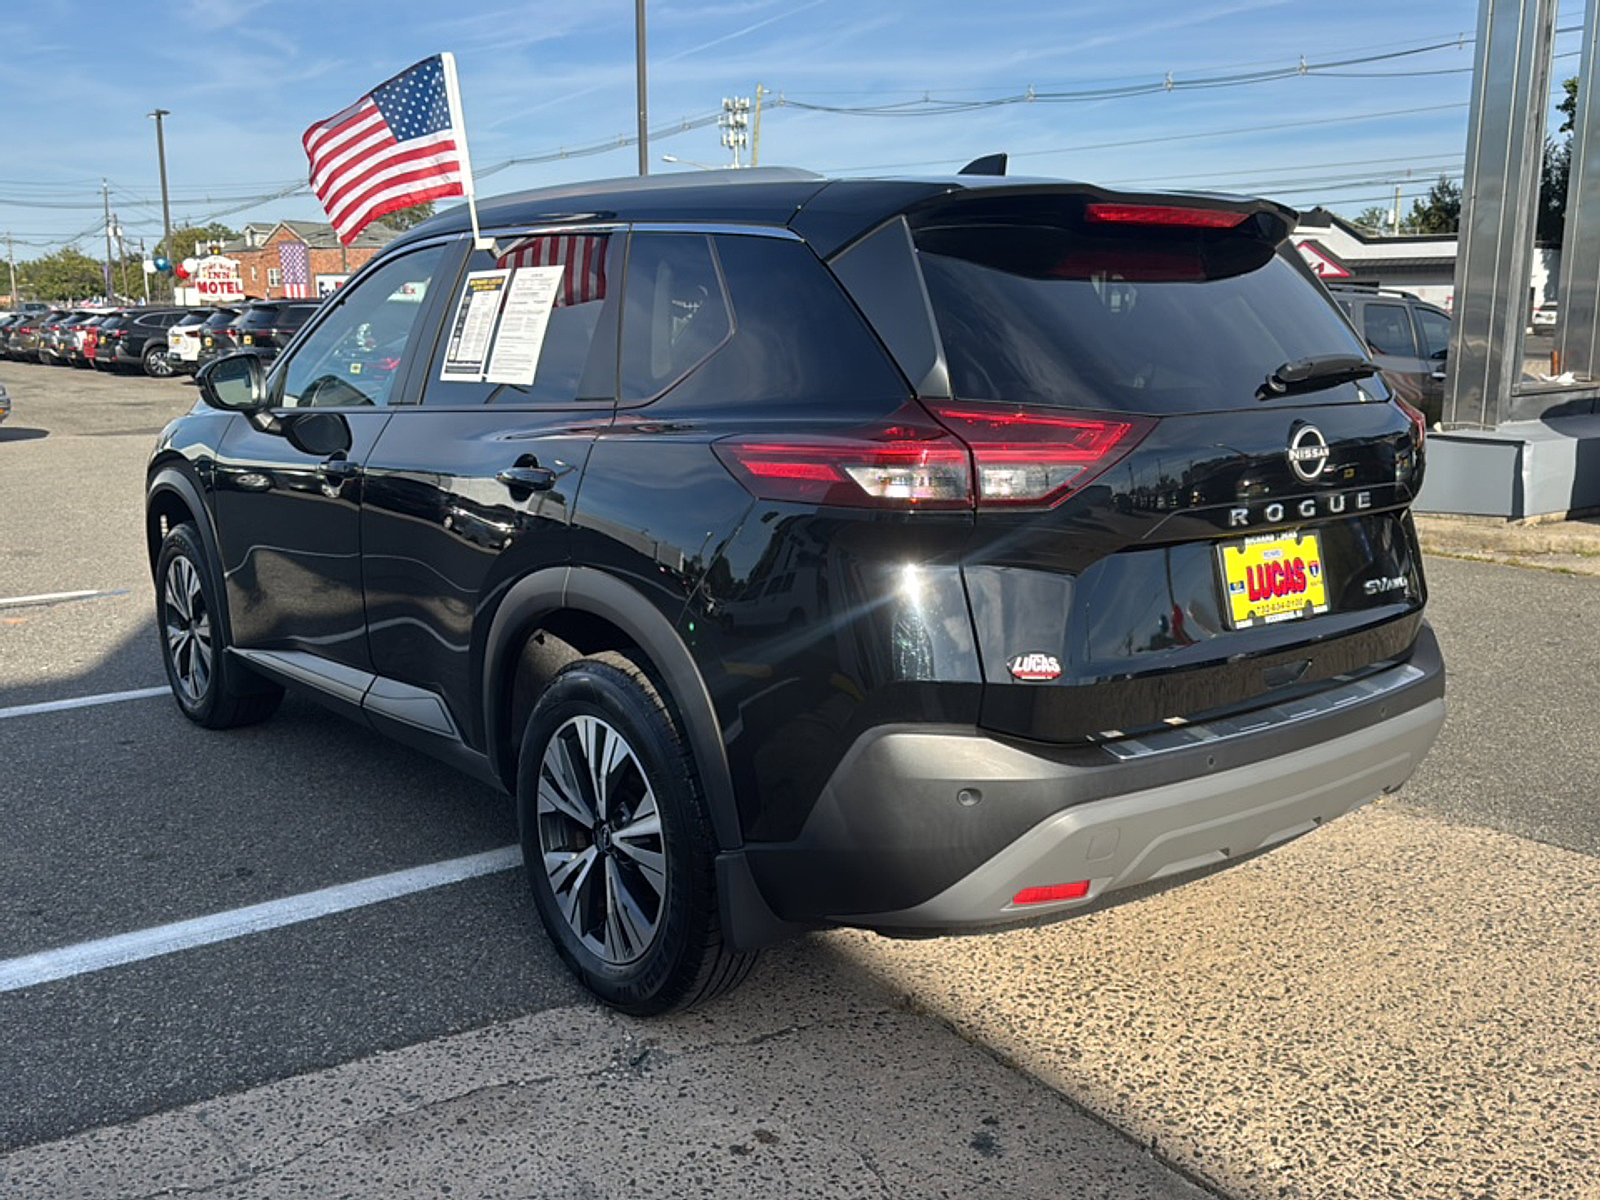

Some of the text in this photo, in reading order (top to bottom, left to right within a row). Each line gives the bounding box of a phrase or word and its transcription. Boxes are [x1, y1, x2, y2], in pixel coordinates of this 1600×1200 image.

[208, 272, 230, 280] INN
[197, 281, 244, 294] MOTEL
[1289, 447, 1330, 461] NISSAN
[1229, 491, 1372, 526] ROGUE
[1246, 557, 1307, 602] LUCAS
[1012, 656, 1061, 673] LUCAS
